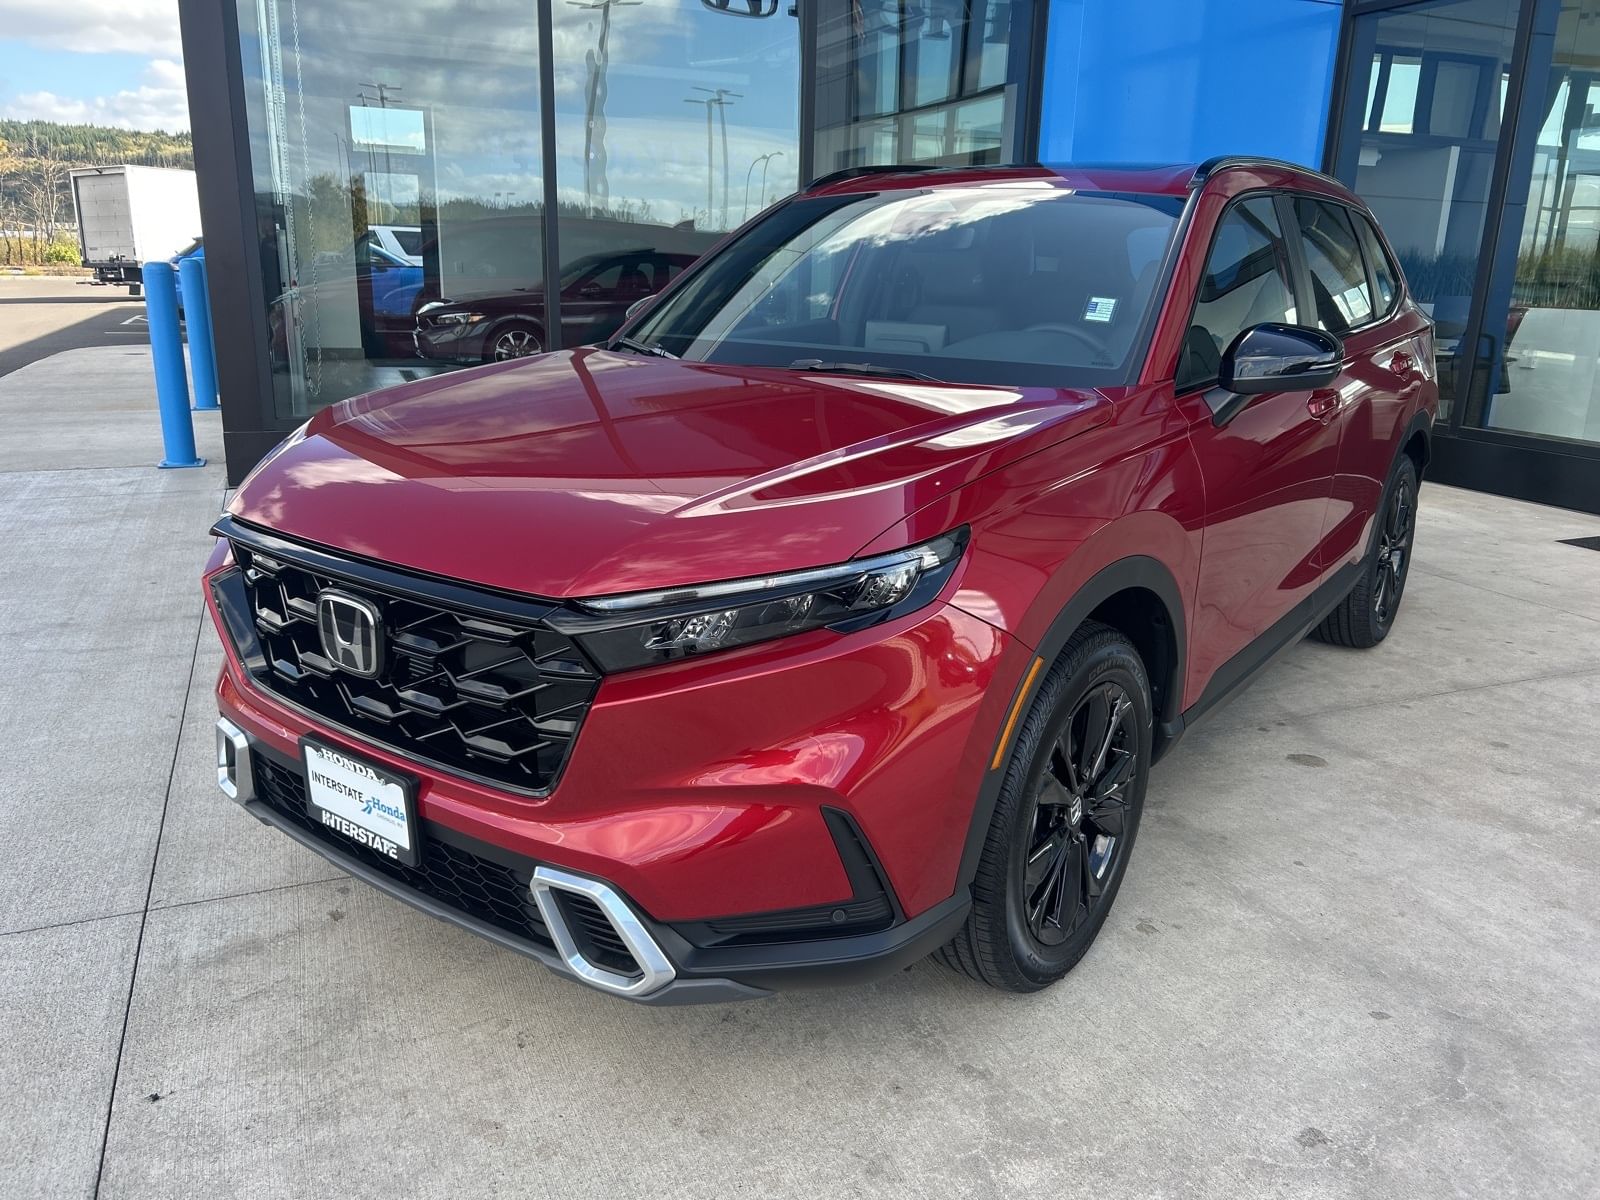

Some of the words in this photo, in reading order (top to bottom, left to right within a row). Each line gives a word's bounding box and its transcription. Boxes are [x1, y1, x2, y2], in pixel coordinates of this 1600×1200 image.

[320, 747, 378, 781] HONDA
[311, 769, 365, 804] INTERSTATE
[371, 796, 406, 822] Honda
[321, 809, 398, 860] INTERSTATE
